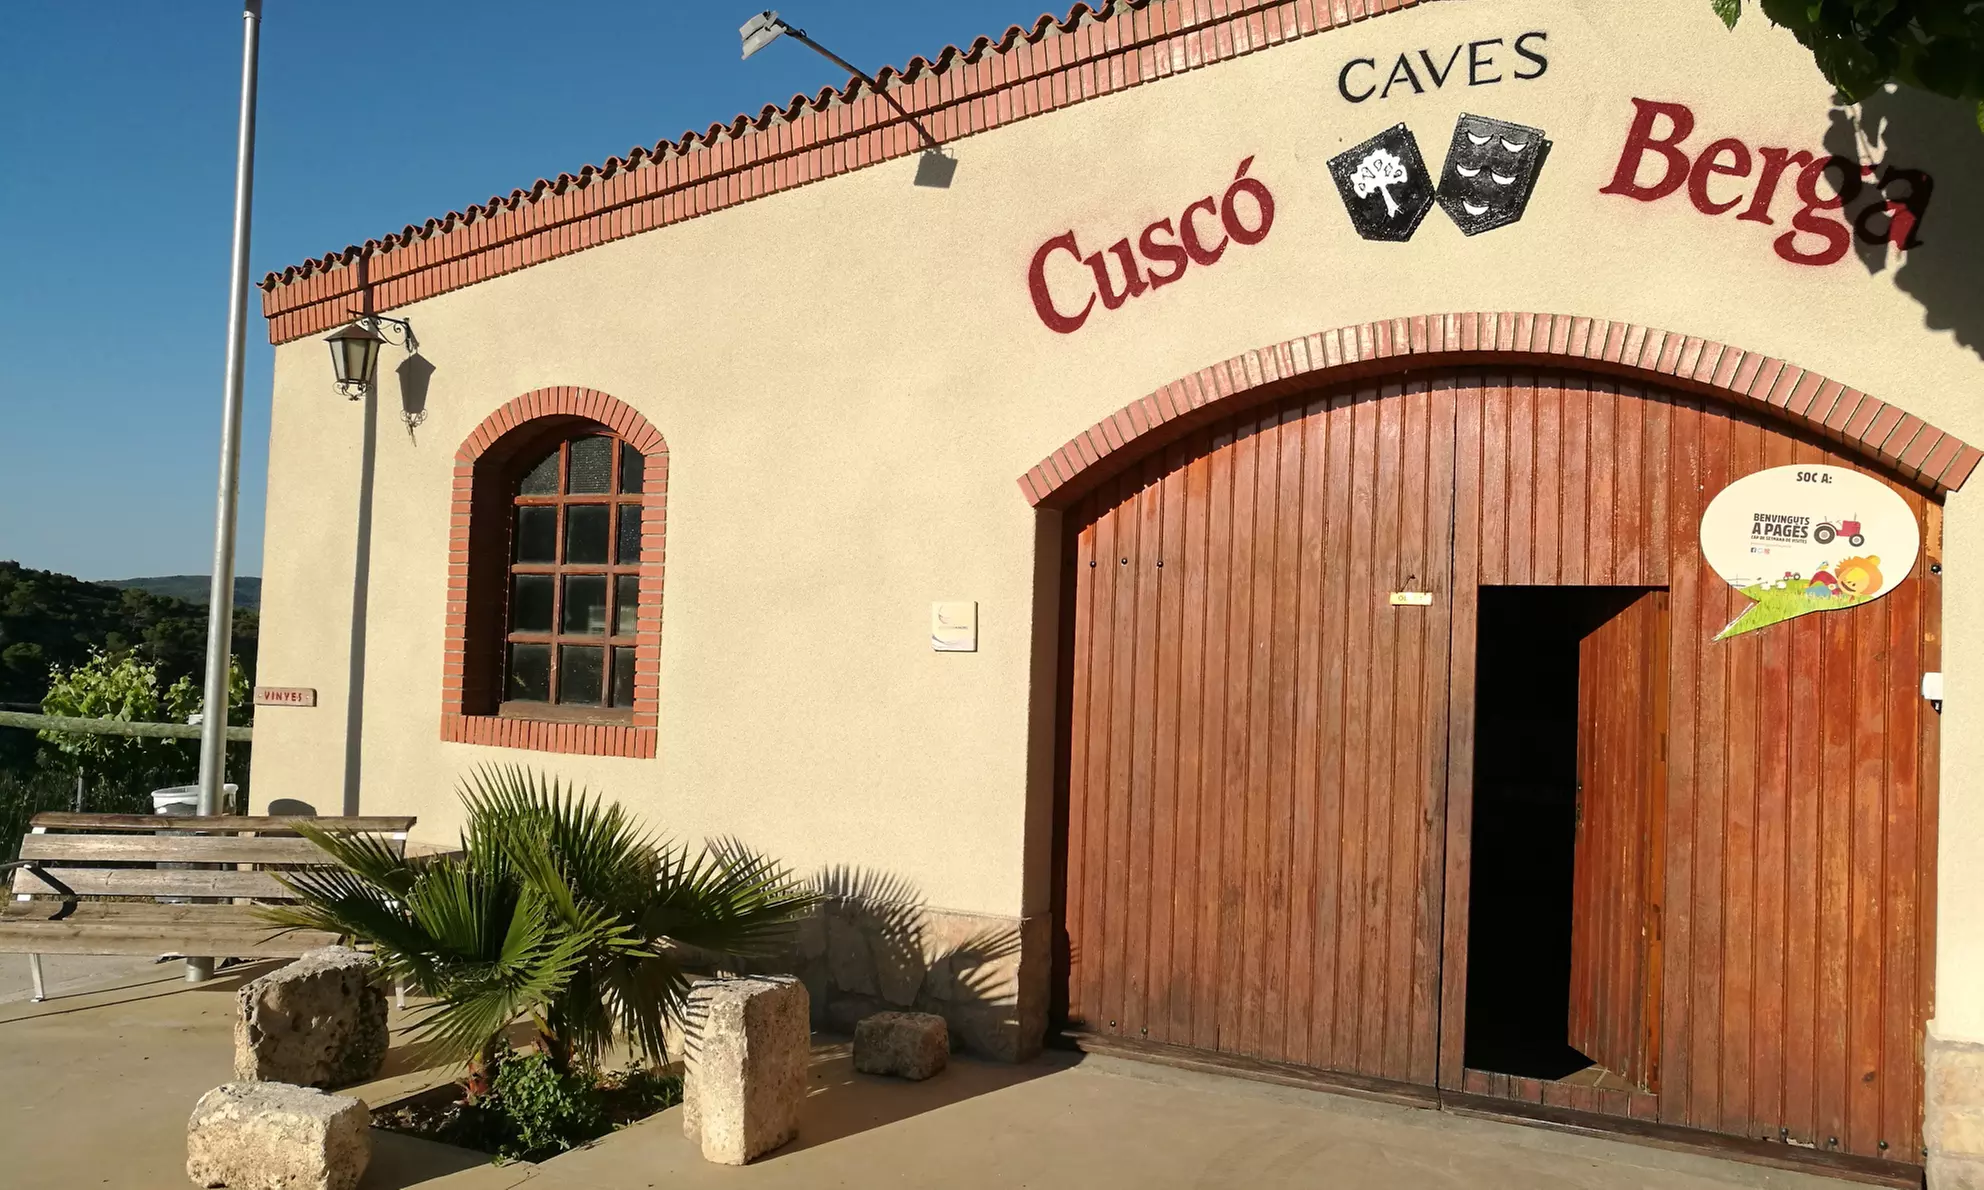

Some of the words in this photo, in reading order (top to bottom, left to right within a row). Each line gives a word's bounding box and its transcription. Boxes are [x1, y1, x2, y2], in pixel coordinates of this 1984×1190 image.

[1338, 31, 1549, 103] CAVES
[1028, 155, 1275, 334] Cuscó
[1599, 97, 1934, 266] Berga
[1796, 471, 1818, 483] SOC
[1821, 473, 1832, 484] A:
[1753, 513, 1810, 526] BENVINGUTS
[1752, 522, 1761, 535] A
[264, 690, 302, 702] VINYES
